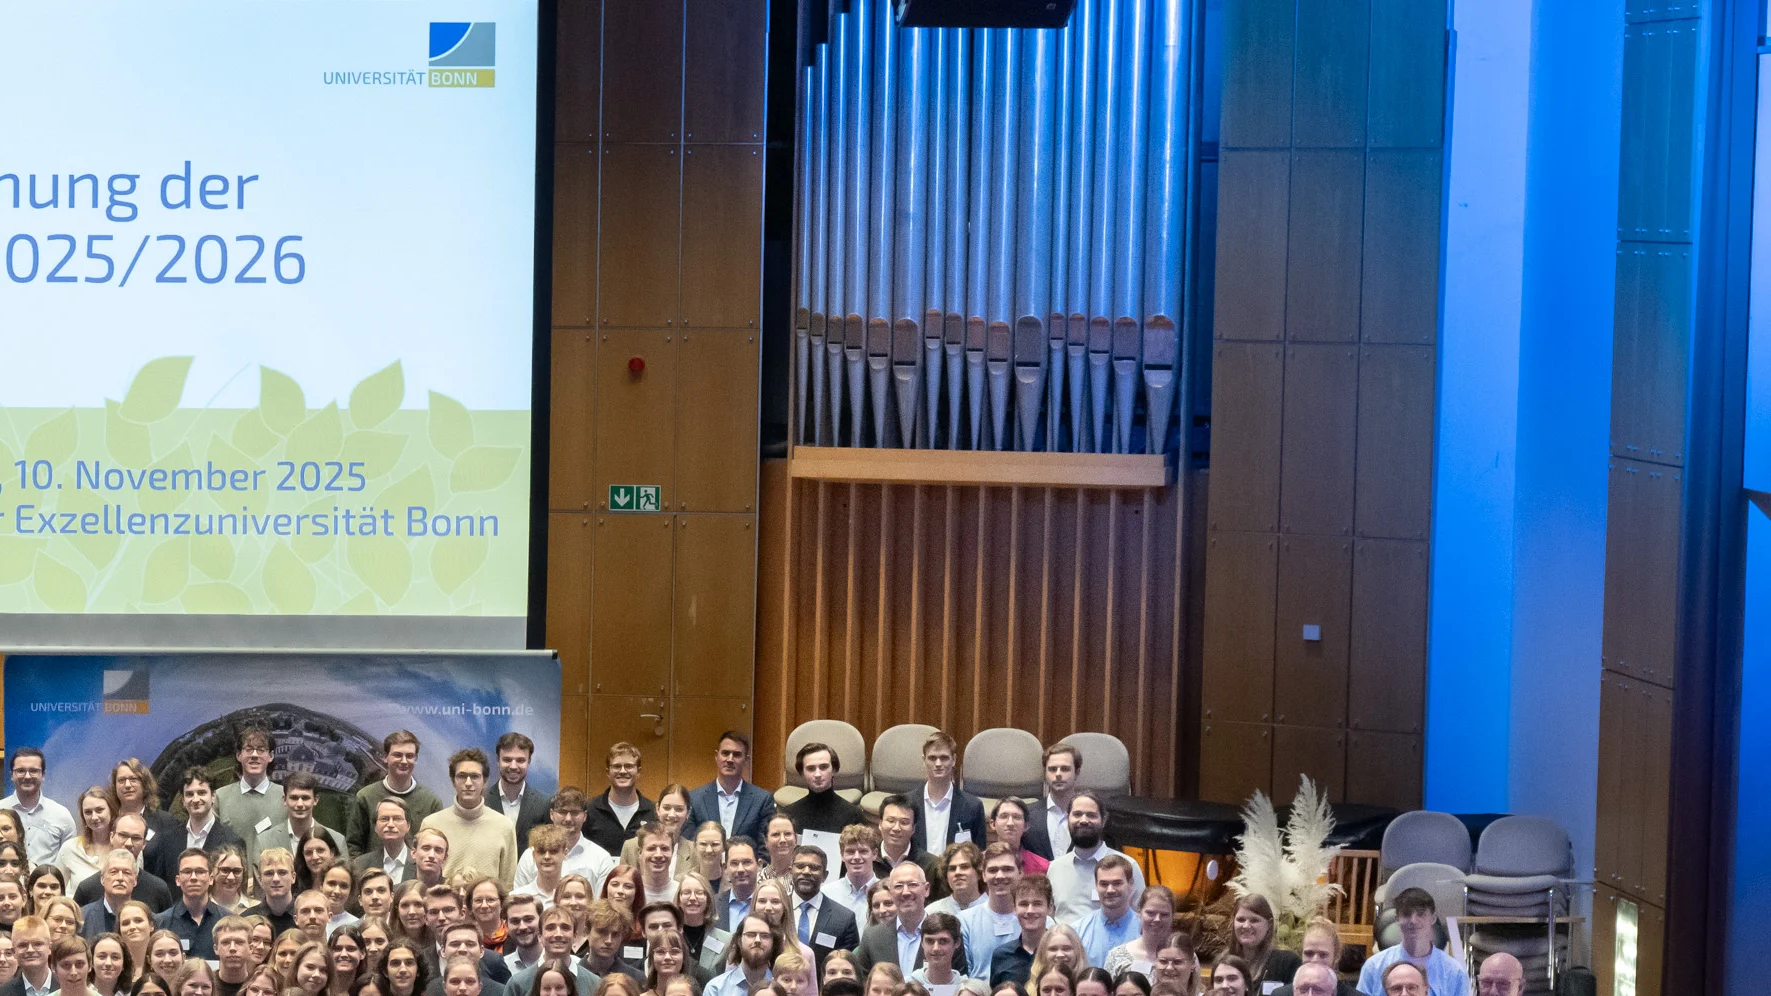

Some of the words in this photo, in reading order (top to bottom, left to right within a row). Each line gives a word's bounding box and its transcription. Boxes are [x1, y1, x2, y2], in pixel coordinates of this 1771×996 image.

[323, 69, 426, 85] UNIVERSITÄT
[431, 71, 478, 86] BONN
[159, 159, 260, 211] der
[13, 459, 63, 491] 10.
[76, 460, 267, 492] November
[276, 461, 367, 492] 2025
[15, 504, 395, 537] Exzellenzuniversität
[406, 505, 500, 537] Bonn
[30, 700, 103, 713] UNIVERSITÄT
[104, 701, 139, 714] BONN
